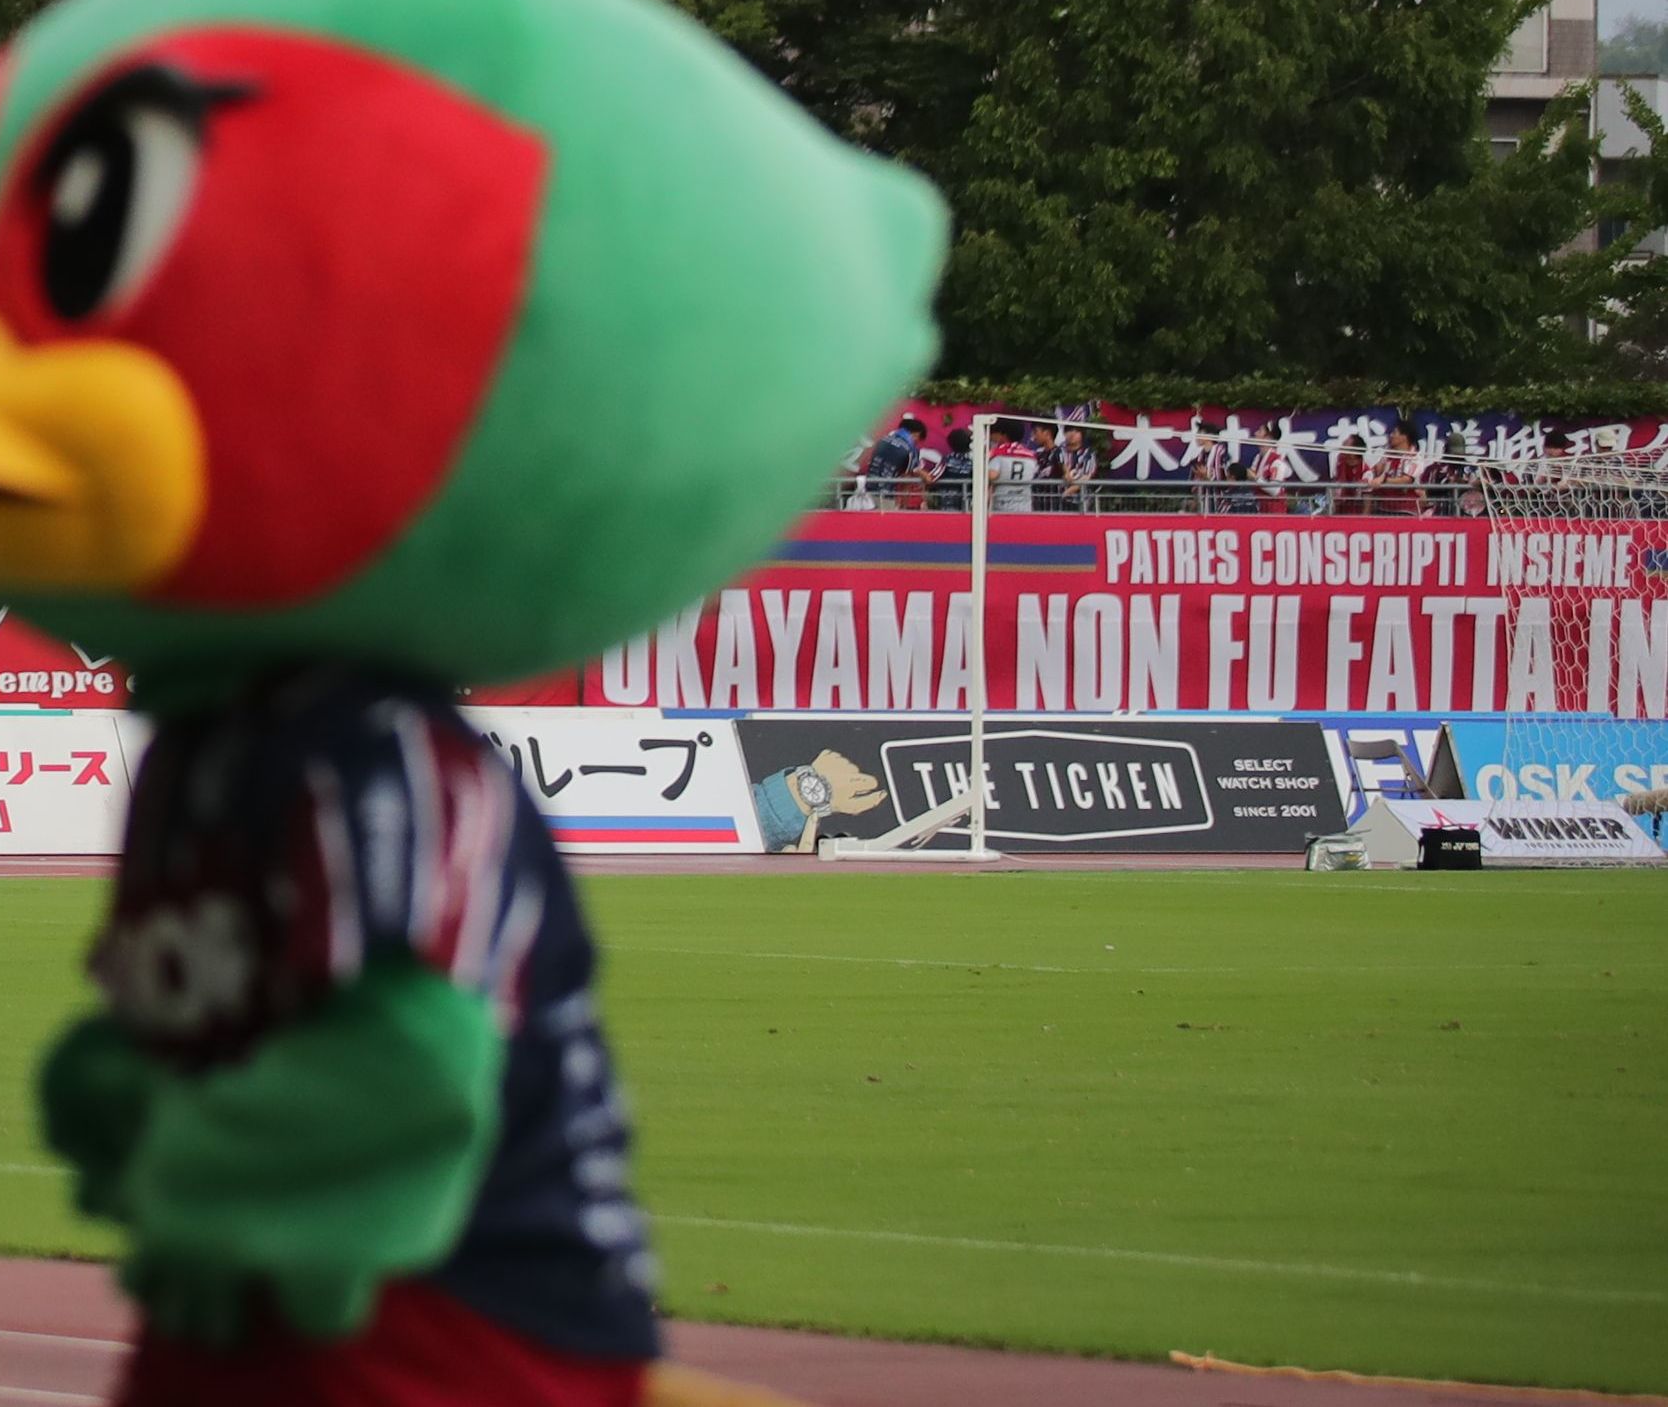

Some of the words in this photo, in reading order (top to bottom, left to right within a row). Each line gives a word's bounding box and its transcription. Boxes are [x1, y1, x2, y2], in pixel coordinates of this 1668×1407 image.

[1105, 528, 1239, 585] PATRES
[1250, 530, 1468, 588] CONSCRIPTI
[1486, 532, 1633, 589] INSIEME
[601, 587, 986, 712] OKAYAMA
[1016, 593, 1181, 713] NON
[1208, 594, 1301, 713] FU
[1325, 595, 1558, 714] FATTA
[482, 729, 714, 802] ループ
[1216, 776, 1272, 790] WATCH
[1274, 776, 1320, 790] SHOP
[1232, 758, 1295, 772] SELECT
[1475, 763, 1598, 802] OSK
[912, 761, 1001, 810] THE
[1014, 761, 1183, 811] TICKEN
[1232, 805, 1278, 818] SINCE
[1279, 804, 1317, 818] 2001
[1484, 816, 1633, 841] WINNER
